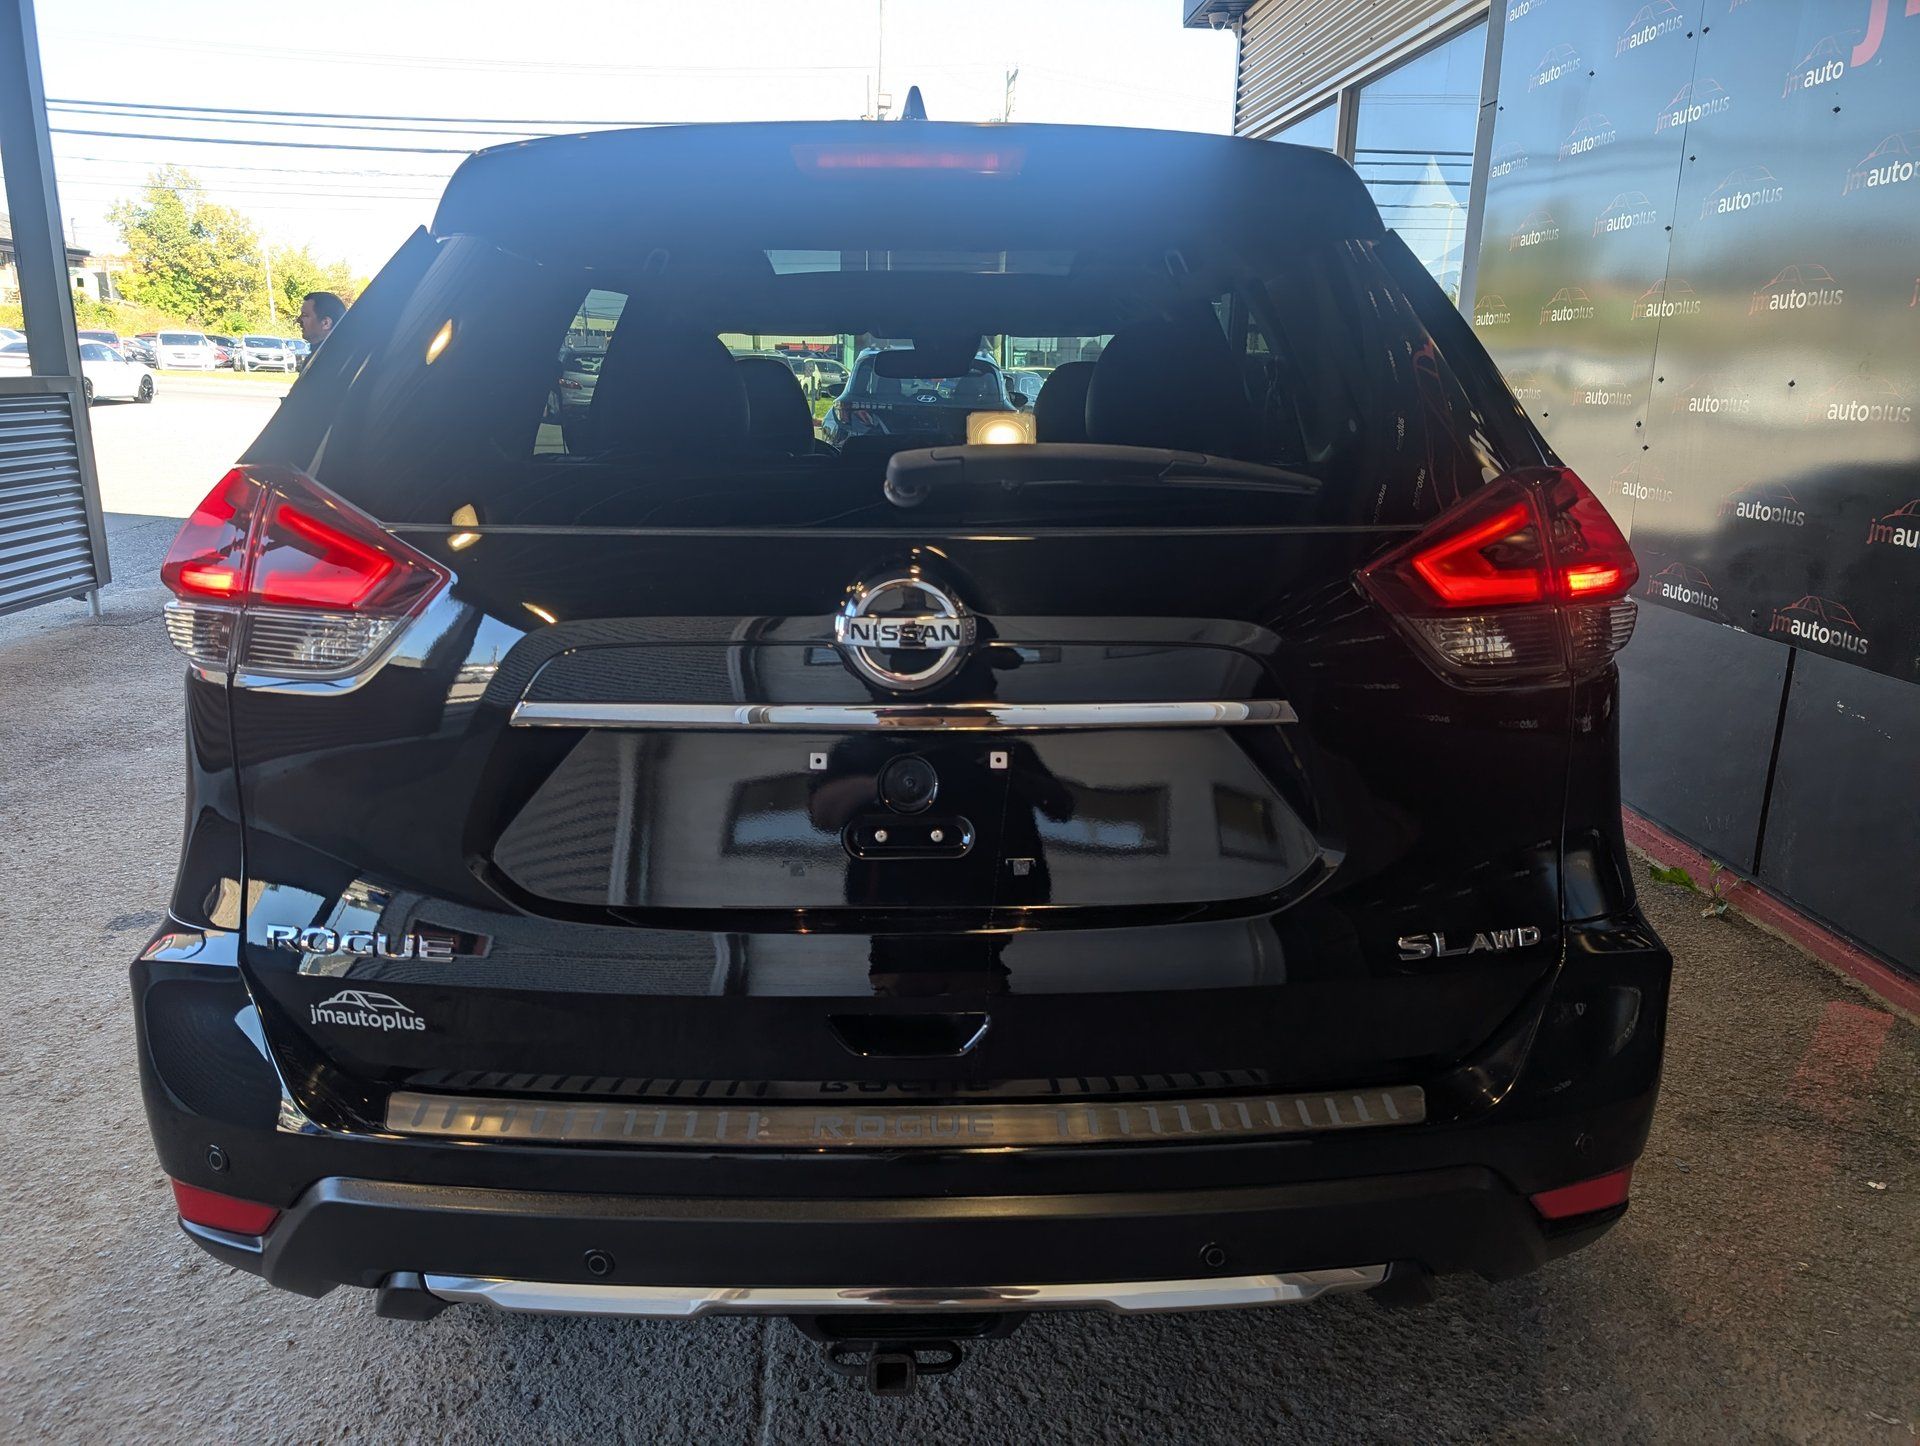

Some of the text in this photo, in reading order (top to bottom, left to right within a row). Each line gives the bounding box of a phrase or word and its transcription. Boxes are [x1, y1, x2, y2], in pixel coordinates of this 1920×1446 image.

[1615, 14, 1684, 58] jmautoplus
[1655, 95, 1730, 135] jmautoplus
[1491, 156, 1528, 178] autoplus
[1700, 186, 1783, 221] jmautoplus
[1593, 209, 1657, 238] jmautoplus
[1540, 305, 1594, 326] jmautoplus
[1631, 298, 1701, 321] jmautoplus
[1749, 288, 1844, 316] jmautoplus
[1475, 311, 1511, 327] autoplus
[1572, 388, 1632, 406] jmautoplus
[1608, 475, 1673, 502] jmautoplus
[1716, 495, 1805, 527] jmautoplus
[1646, 575, 1719, 611] jmautoplus
[851, 623, 960, 641] NISSAN
[1769, 608, 1868, 655] jmautoplus
[267, 923, 455, 962] ROGUE
[311, 1004, 425, 1031] jmautoplus
[812, 1113, 994, 1138] ROGUE
